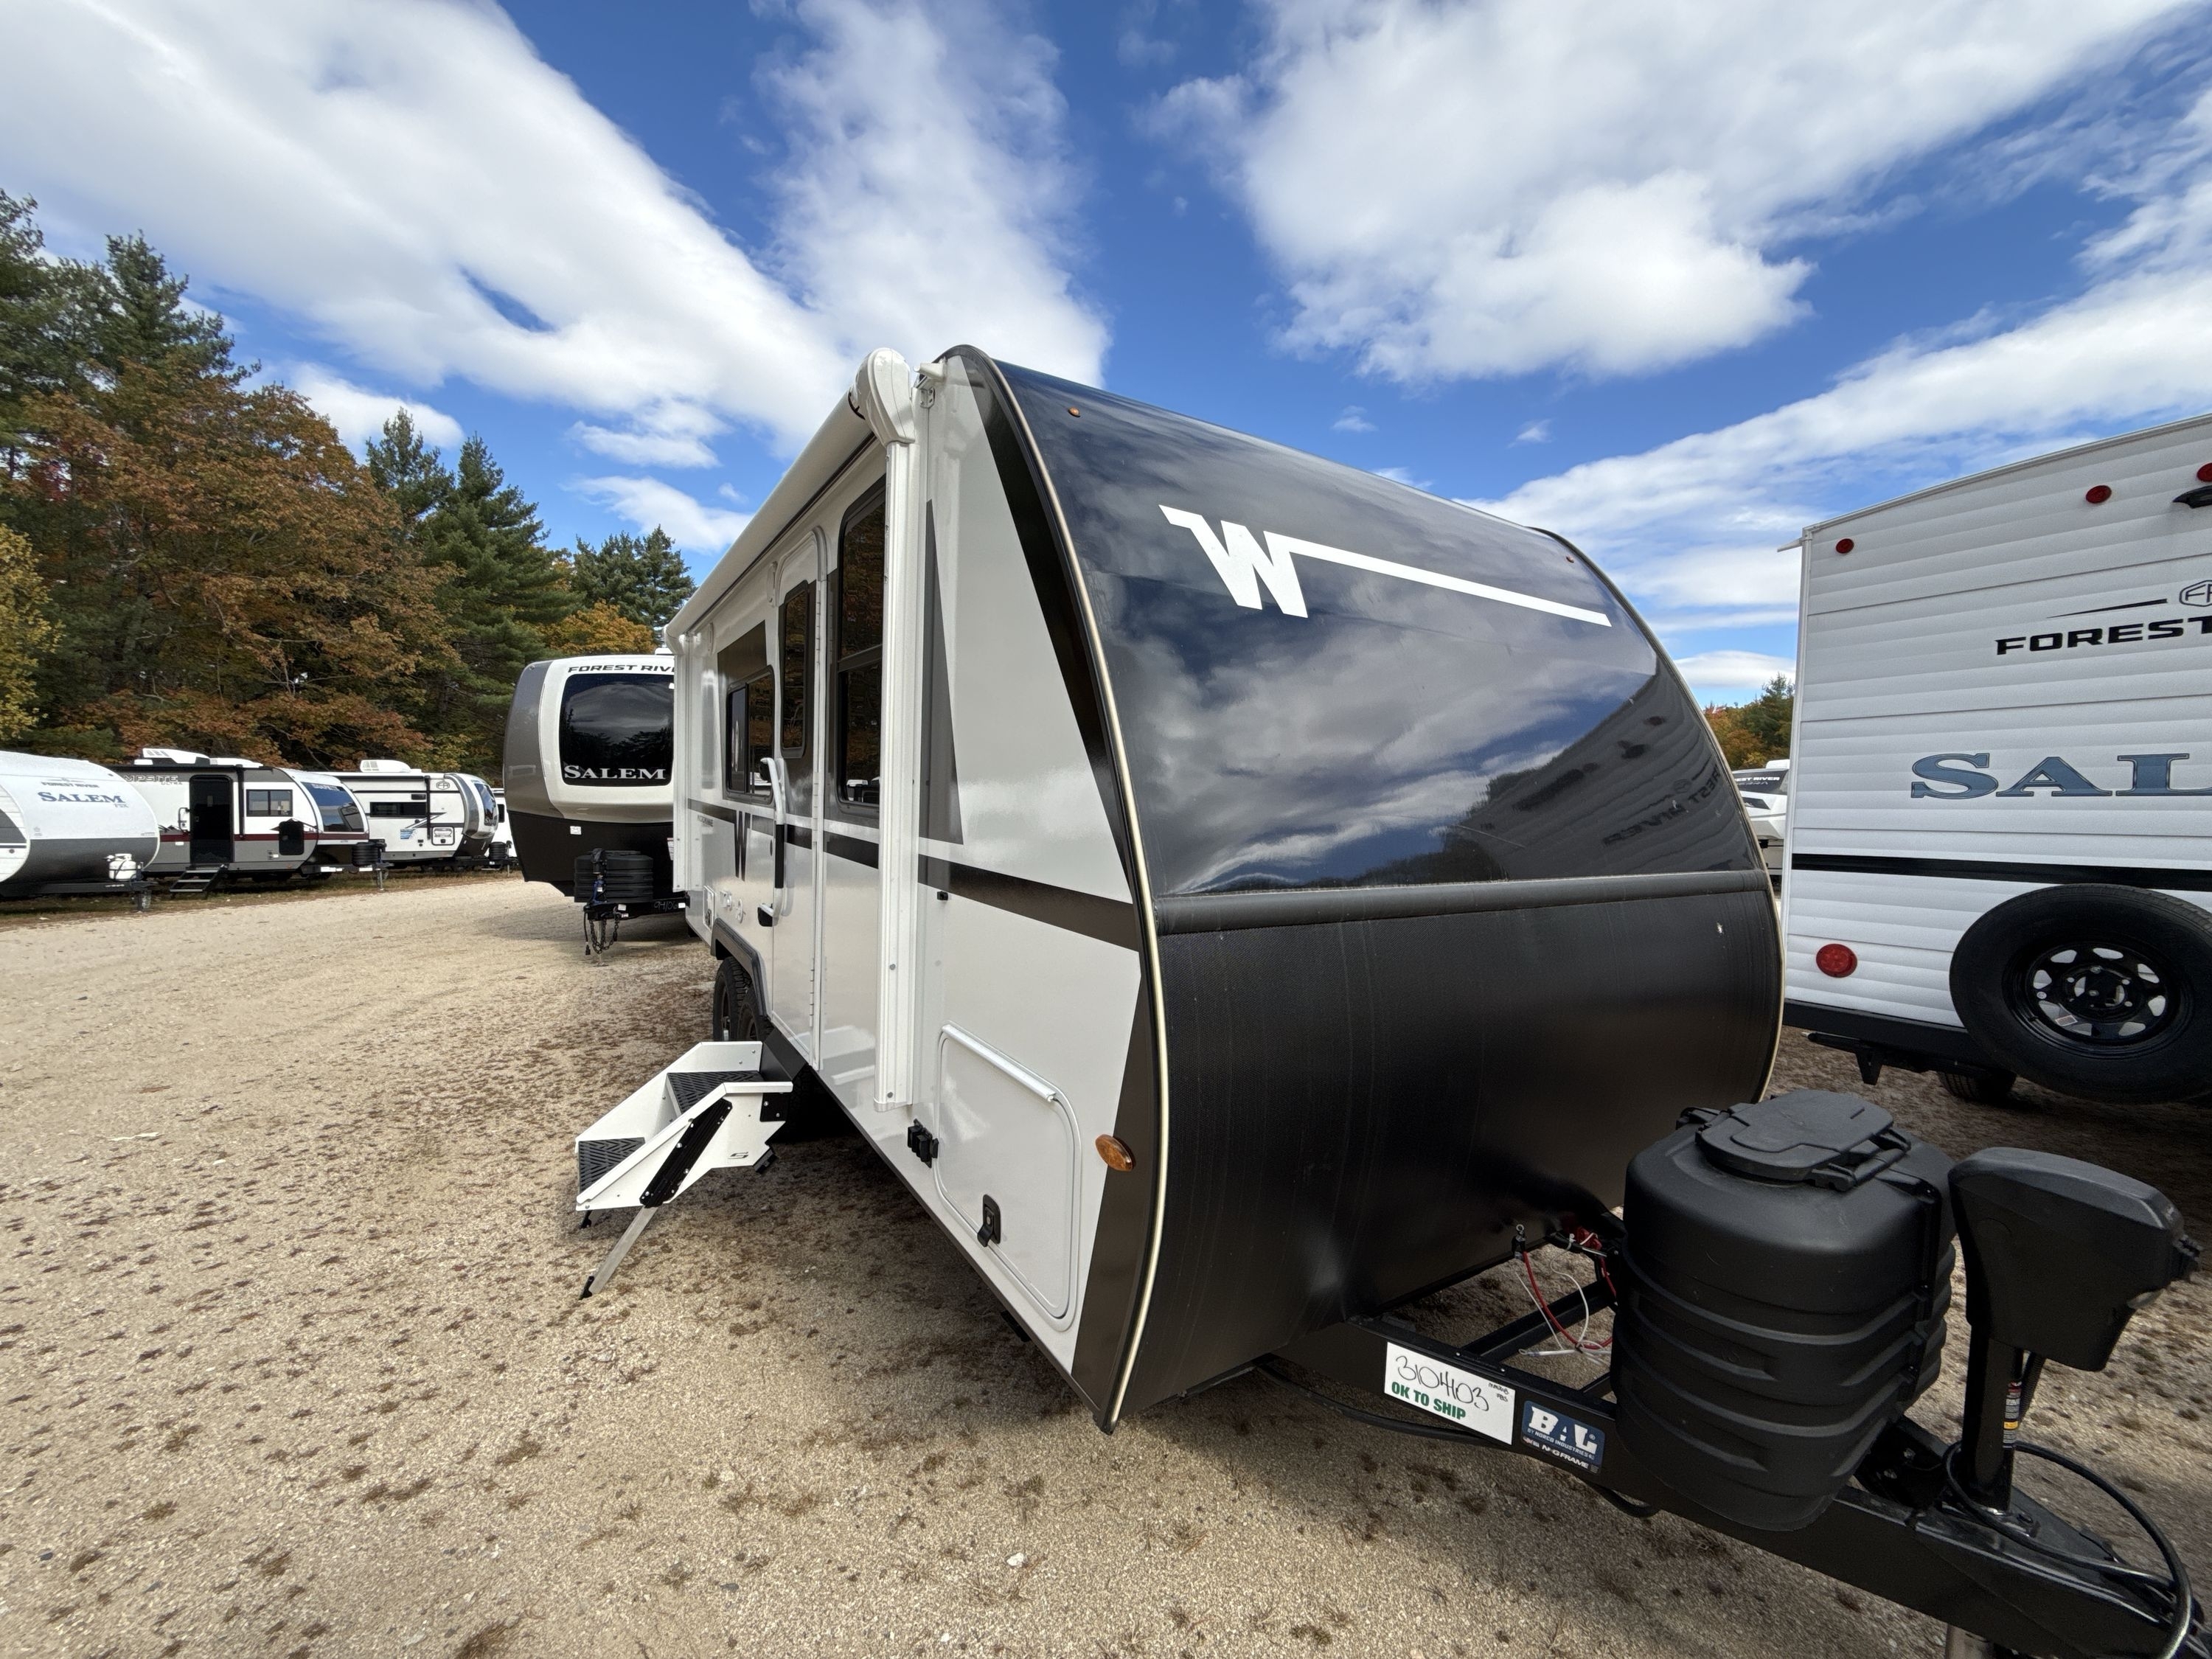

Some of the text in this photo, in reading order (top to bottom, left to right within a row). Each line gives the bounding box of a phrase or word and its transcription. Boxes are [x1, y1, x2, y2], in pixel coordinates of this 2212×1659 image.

[1158, 504, 1308, 618] W
[1994, 615, 2212, 655] FOREST
[564, 765, 666, 779] SALEM
[1910, 753, 2212, 799] SAL
[38, 791, 125, 804] SALEM
[1391, 1381, 1466, 1420] OK TO SHIP
[1528, 1405, 1598, 1455] BAL
[1535, 1430, 1554, 1443] NORCO
[1560, 1453, 1589, 1469] FRAME
